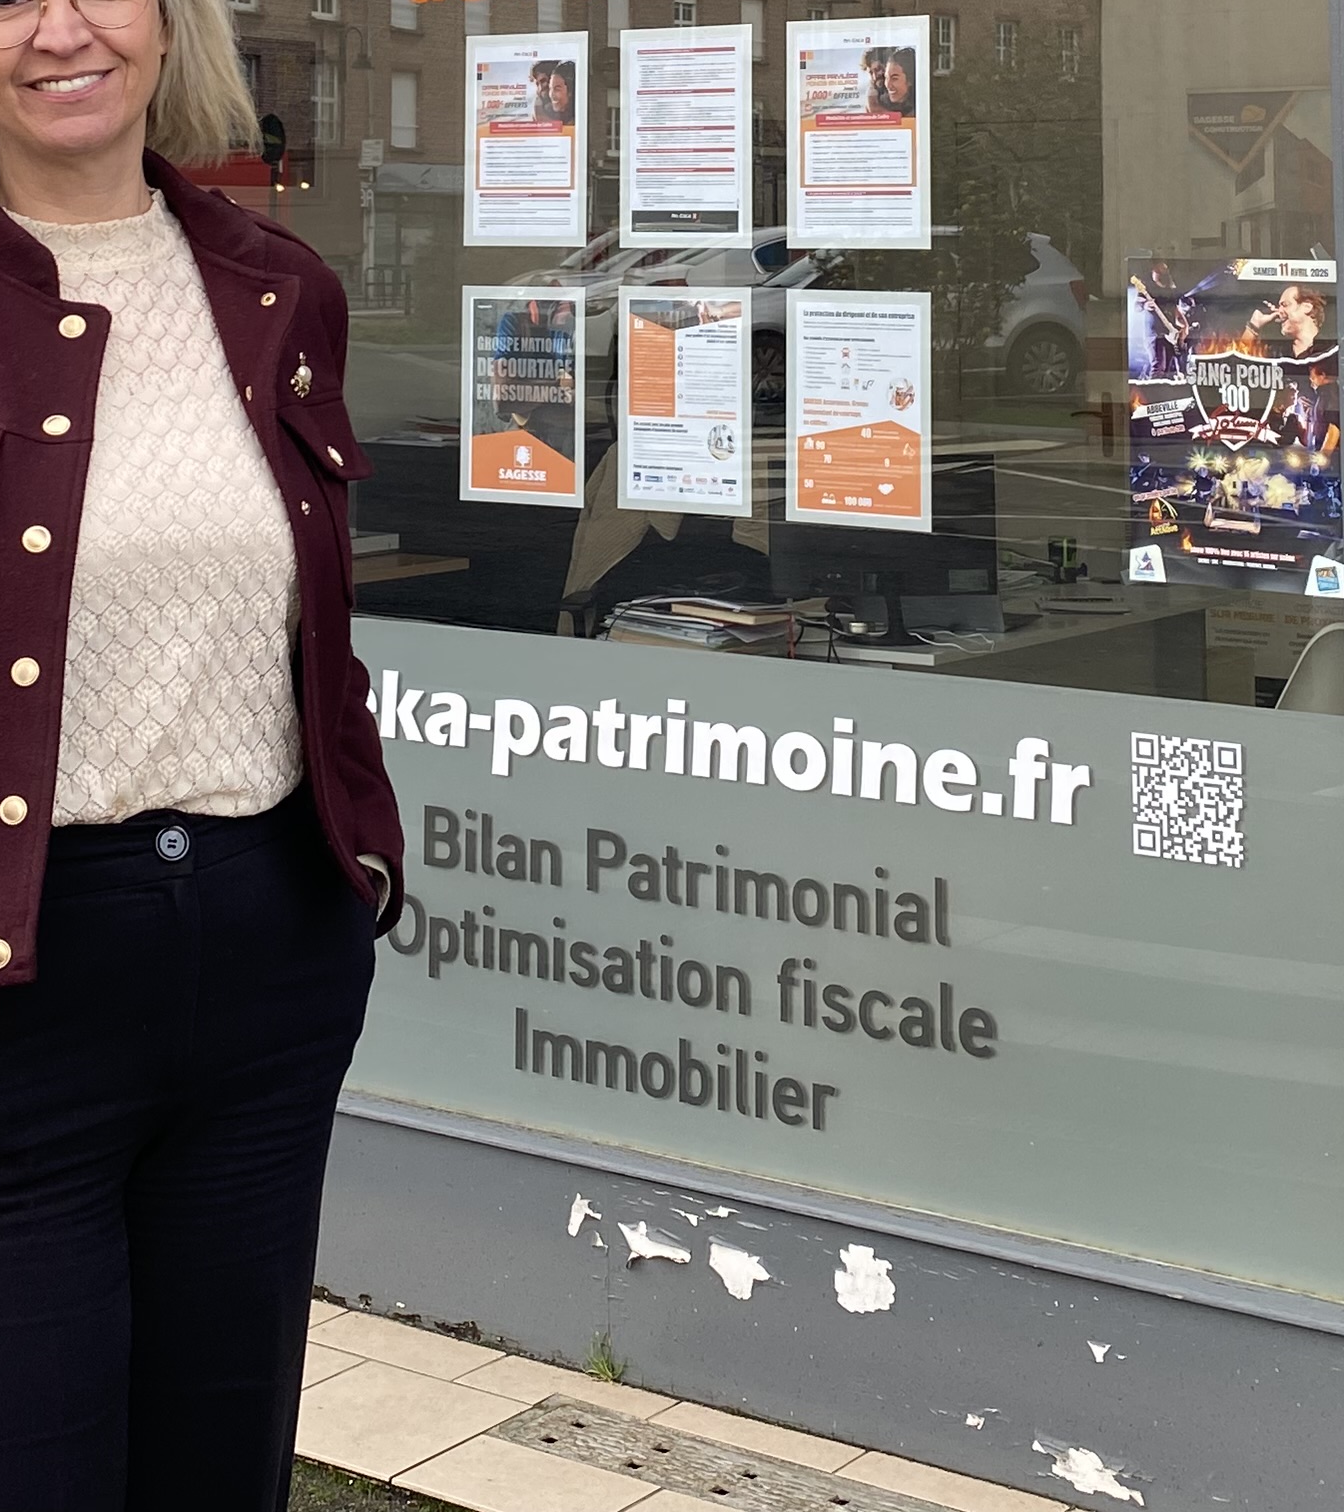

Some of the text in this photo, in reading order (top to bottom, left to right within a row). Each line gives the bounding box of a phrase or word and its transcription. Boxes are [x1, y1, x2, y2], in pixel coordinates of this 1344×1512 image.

[1253, 267, 1277, 276] SAMEDI
[1279, 263, 1289, 276] 11
[1310, 268, 1329, 277] 2026
[477, 336, 520, 353] GROUPE
[477, 357, 572, 378] DE COURTAGE
[1186, 362, 1284, 390] SANG POUR
[477, 383, 572, 404] EN ASSURANCES
[1219, 386, 1250, 413] 100
[861, 428, 872, 438] 40
[823, 454, 832, 464] 70
[498, 468, 547, 481] SAGESSE
[422, 804, 952, 949] Bilan Patrimonial
[387, 894, 1000, 1060] Optimisation fiscale
[513, 1007, 839, 1133] Immobilier
